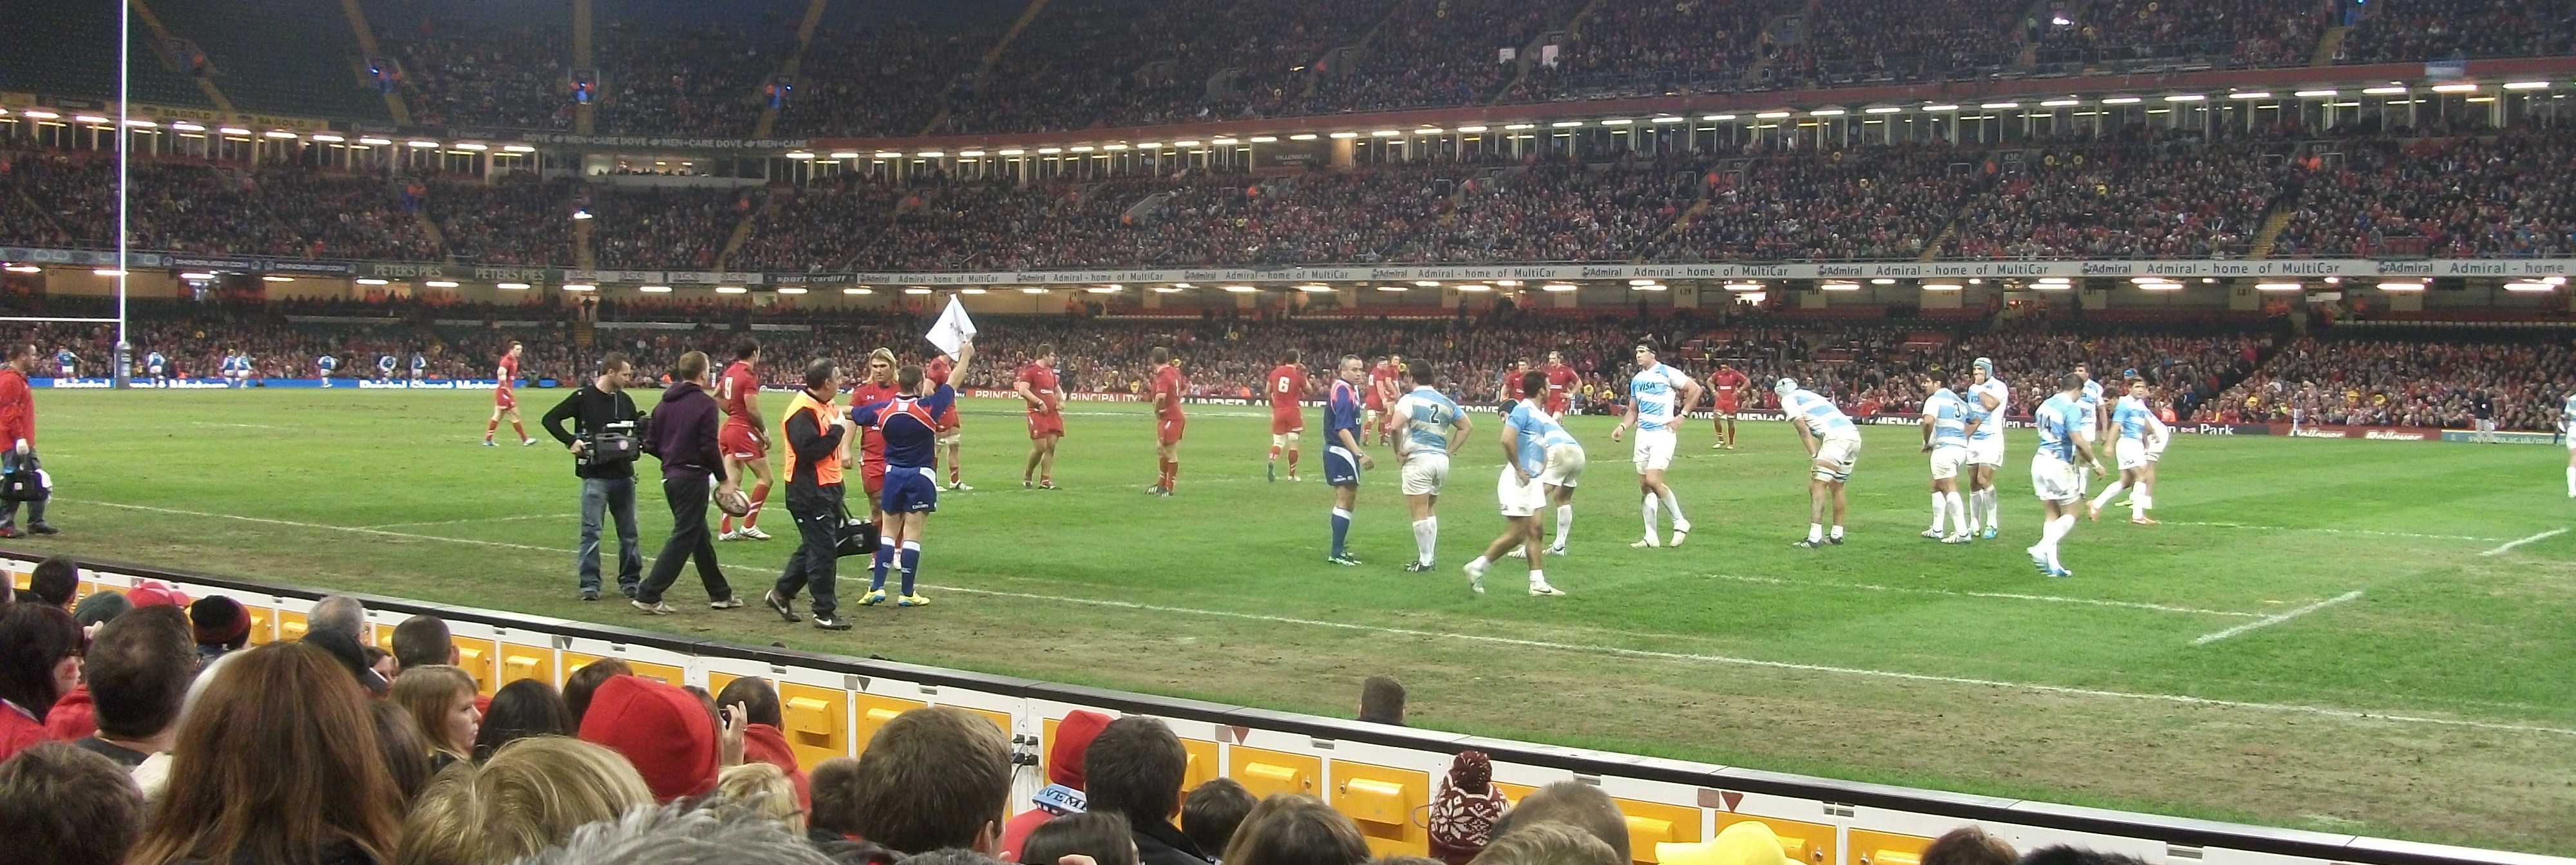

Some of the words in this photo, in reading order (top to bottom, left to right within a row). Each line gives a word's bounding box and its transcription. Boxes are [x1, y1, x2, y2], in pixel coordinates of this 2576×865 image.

[620, 137, 648, 146] DOVE
[716, 139, 743, 148] DOVE
[419, 266, 442, 277] PIES
[1589, 268, 1622, 276] Admiral
[1633, 267, 1674, 277] Admiral
[1687, 267, 1716, 276] home
[1723, 266, 1734, 276] of
[1742, 266, 1788, 276] MultiCar
[1828, 267, 1862, 275] Admiral
[1876, 265, 1920, 276] Admiral
[1935, 265, 1966, 275] home
[1976, 265, 1988, 274] of
[1997, 264, 2049, 274] MultiCar
[2092, 264, 2131, 274] Admiral
[2146, 263, 2196, 274] Admiral
[2213, 263, 2248, 274] home
[2259, 263, 2272, 274] of
[2282, 263, 2340, 273] MultiCar
[2389, 262, 2433, 272] Admiral
[2450, 262, 2506, 274] Admiral
[2525, 262, 2564, 273] home
[522, 269, 545, 281] PIES
[777, 274, 806, 283] sport
[813, 274, 847, 283] cardiff
[1054, 273, 1083, 281] Admiral
[1226, 271, 1257, 280] Admiral
[1311, 271, 1348, 279] MultiCar
[1417, 269, 1454, 278] Admiral
[1465, 269, 1490, 278] home
[1497, 268, 1507, 278] of
[1514, 268, 1556, 278] MultiCar
[724, 376, 734, 400] 9
[1278, 376, 1290, 393] 6
[1638, 381, 1656, 392] VISA
[1430, 403, 1441, 425] 2
[1953, 402, 1962, 419] 3
[2038, 412, 2052, 432] 14
[2199, 423, 2233, 435] Park
